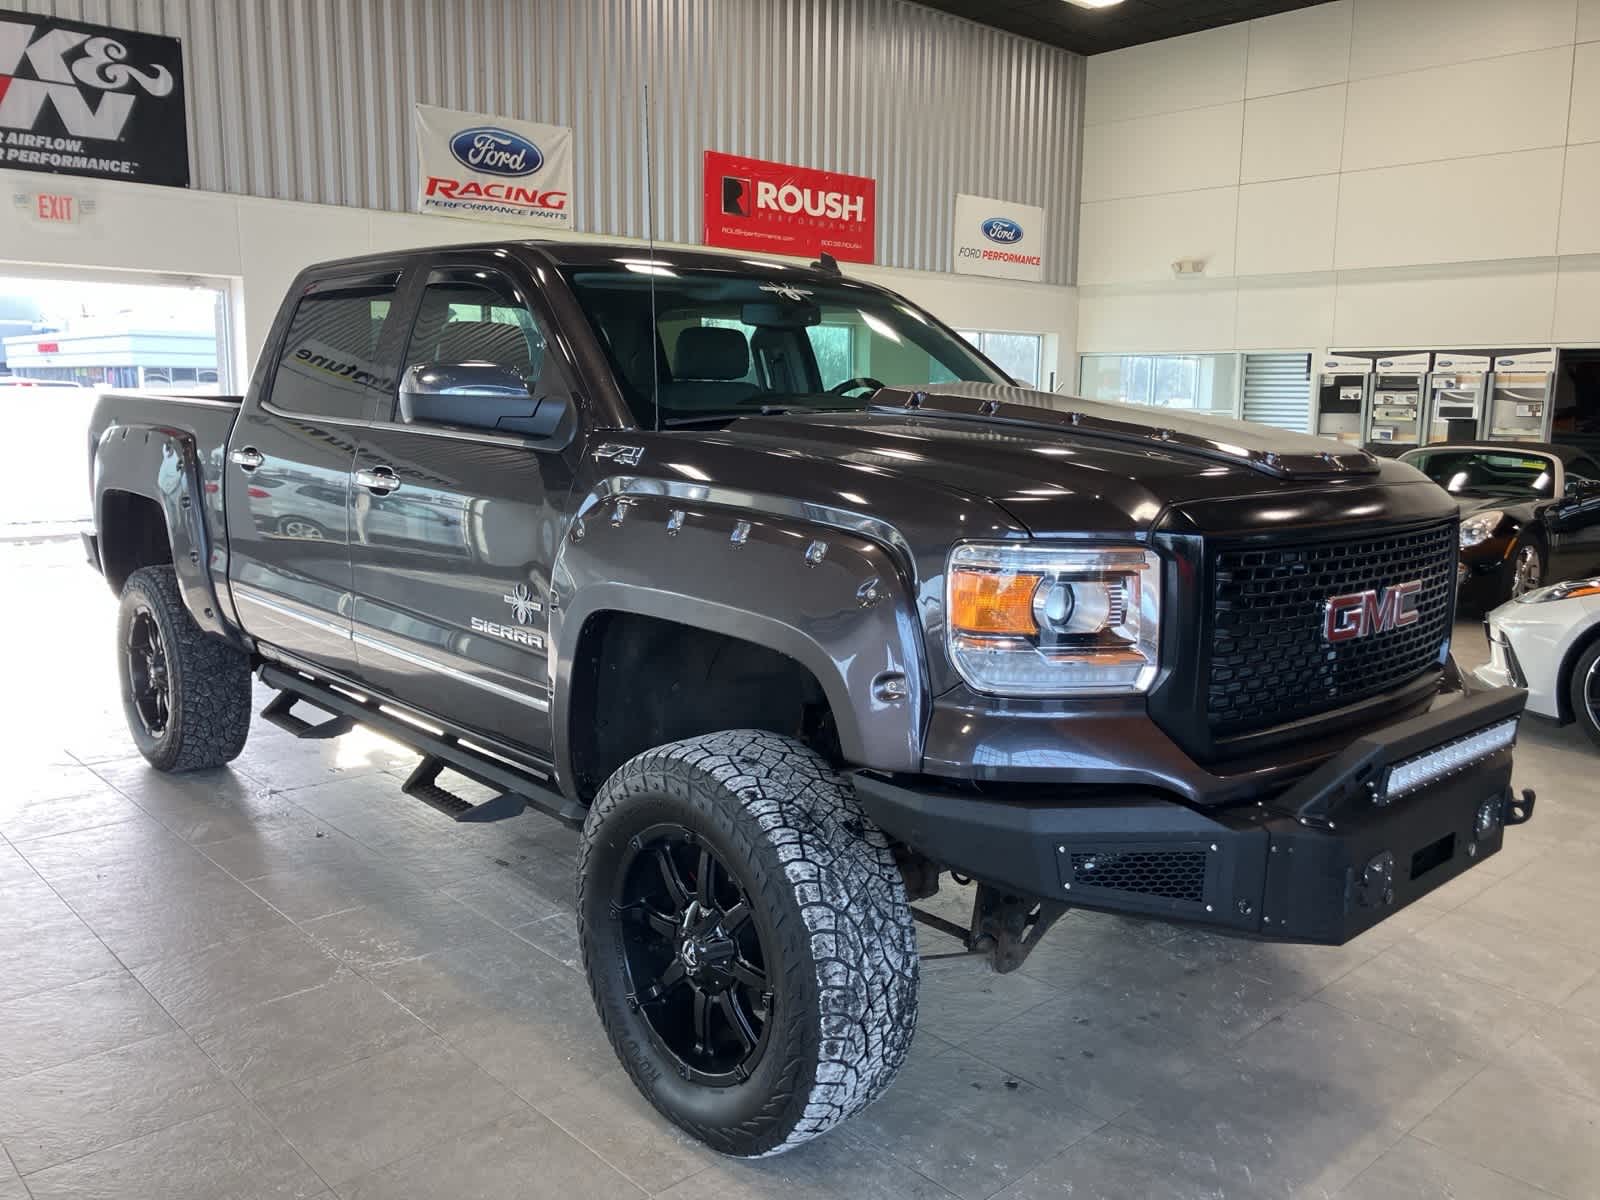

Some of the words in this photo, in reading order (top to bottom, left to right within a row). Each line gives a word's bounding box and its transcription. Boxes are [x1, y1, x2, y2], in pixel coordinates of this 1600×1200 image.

[6, 132, 84, 153] AIRFLOW.
[468, 134, 527, 171] Ford
[38, 193, 72, 220] EXIT
[425, 176, 568, 210] RACING
[757, 181, 864, 222] ROUSH
[425, 199, 528, 216] PERFORMANCE
[530, 210, 568, 220] PARTS
[989, 221, 1016, 240] Ford
[959, 247, 981, 259] FORD
[982, 250, 1041, 266] PERFORMANCE
[1323, 580, 1422, 642] GMC
[471, 616, 545, 649] SIERRA
